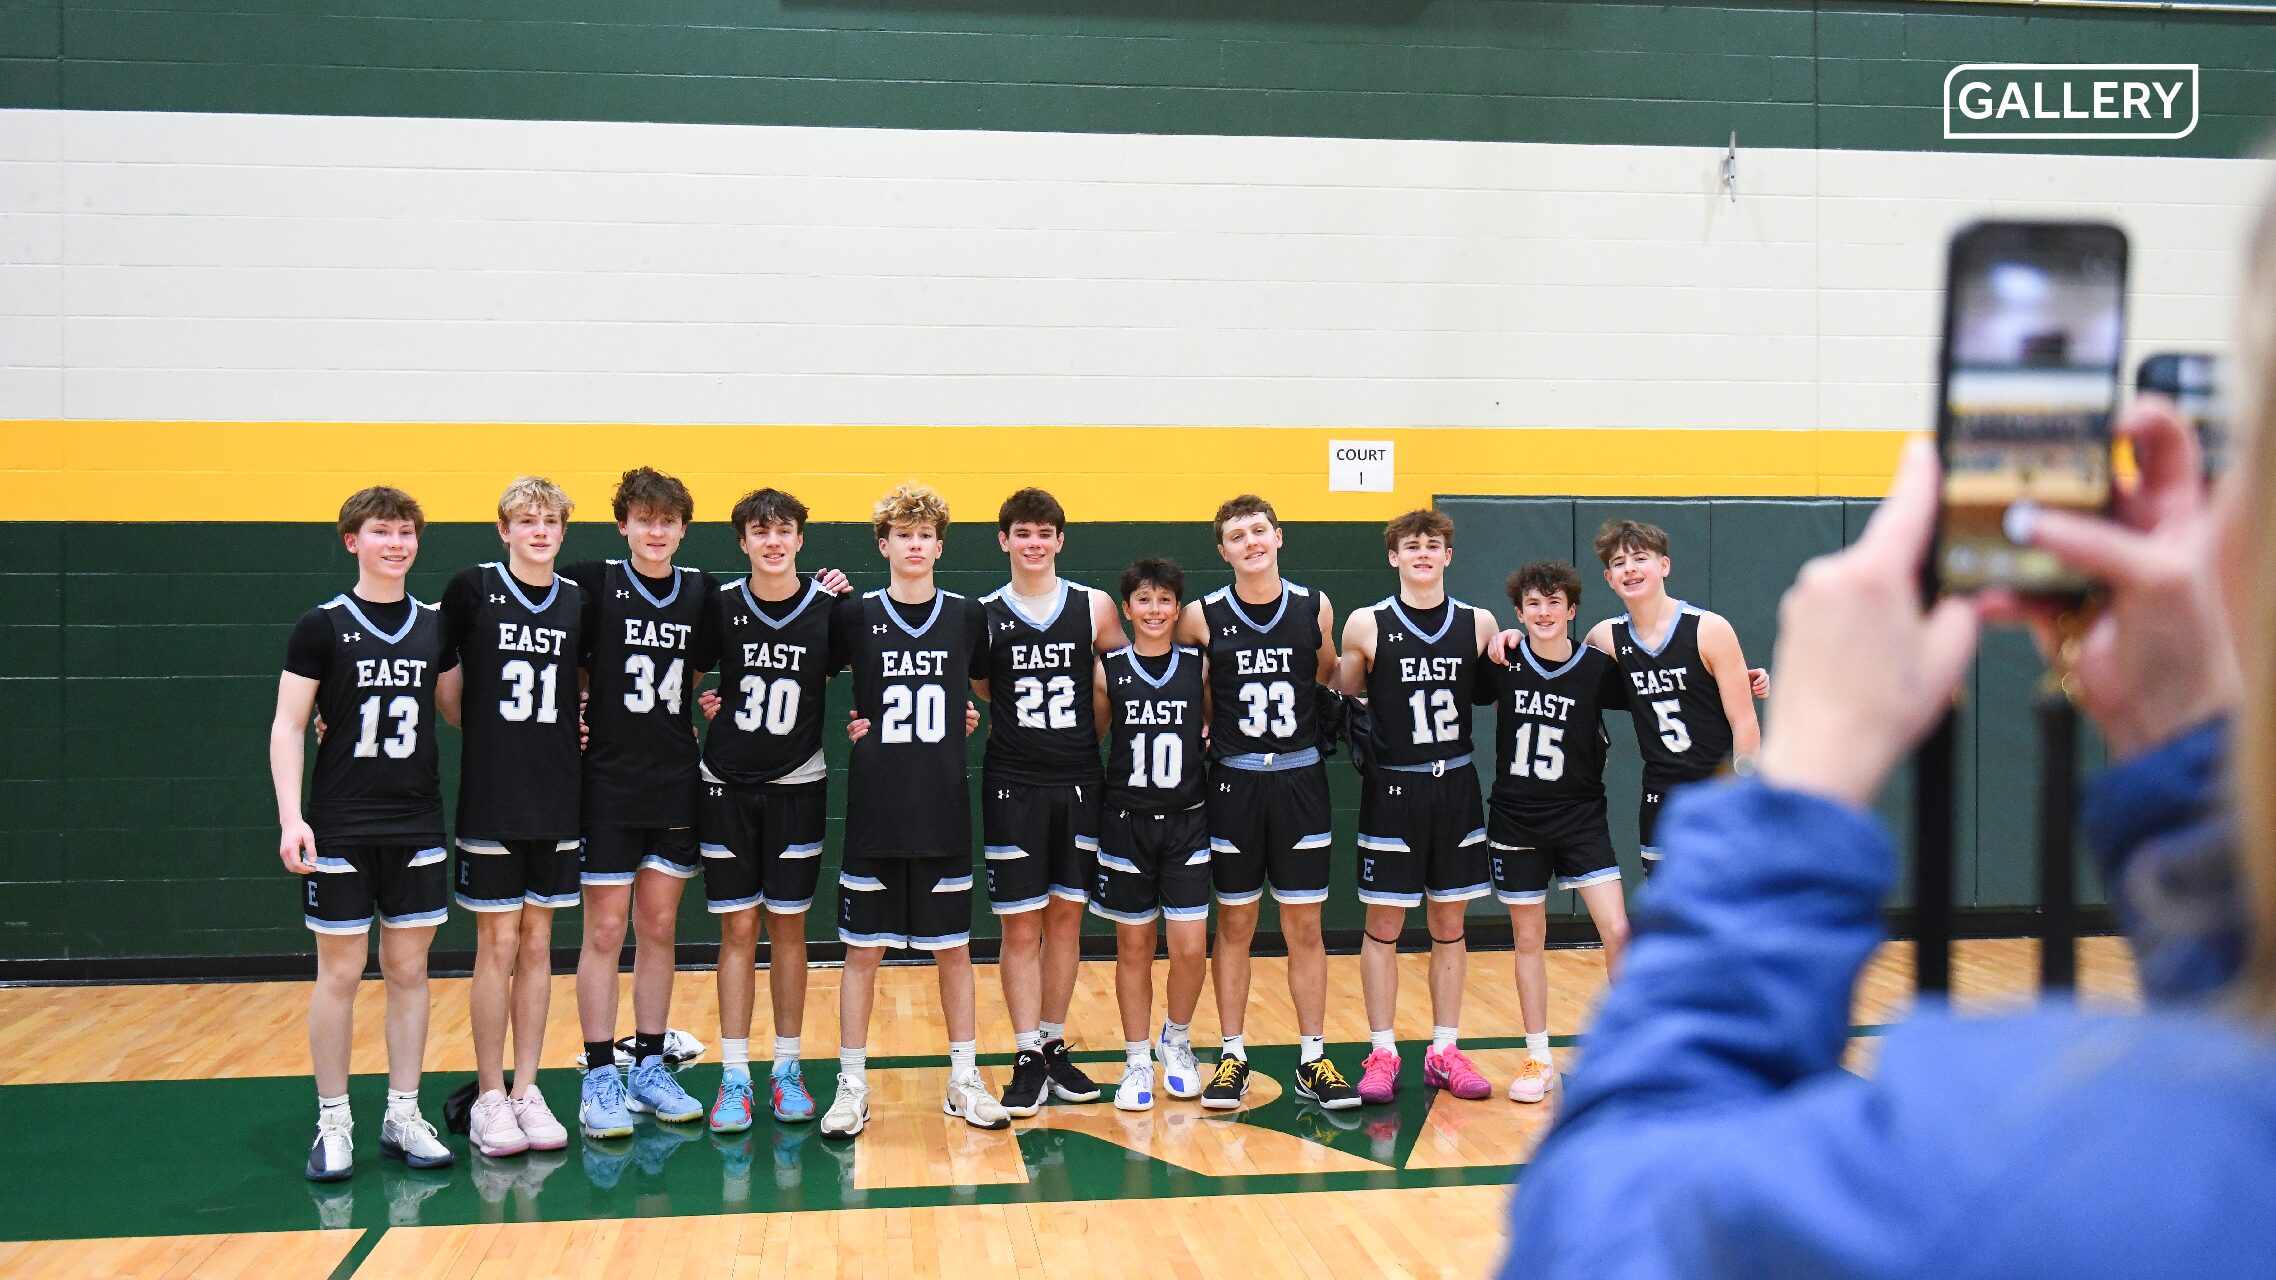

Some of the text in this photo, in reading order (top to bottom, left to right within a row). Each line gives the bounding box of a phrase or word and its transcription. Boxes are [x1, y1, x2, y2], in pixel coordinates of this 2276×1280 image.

[1336, 448, 1387, 461] COURT
[499, 623, 566, 655] EAST
[625, 619, 691, 649] EAST
[743, 643, 806, 671] EAST
[882, 651, 948, 677] EAST
[1012, 643, 1075, 669] EAST
[1236, 648, 1292, 674] EAST
[1400, 658, 1462, 682] EAST
[357, 659, 427, 687] EAST
[624, 654, 684, 714] 34
[1631, 667, 1686, 695] EAST
[500, 660, 558, 723] 31
[735, 675, 801, 735] 30
[1015, 676, 1076, 729] 22
[1515, 690, 1575, 720] EAST
[882, 684, 945, 743] 20
[1125, 700, 1187, 724] EAST
[1239, 681, 1297, 738] 33
[1409, 689, 1459, 744] 12
[354, 696, 419, 758] 13
[1652, 700, 1692, 753] 5
[1128, 733, 1182, 788] 10
[1510, 723, 1564, 781] 15
[1363, 858, 1374, 881] E
[1493, 857, 1504, 881] E
[307, 880, 318, 907] E
